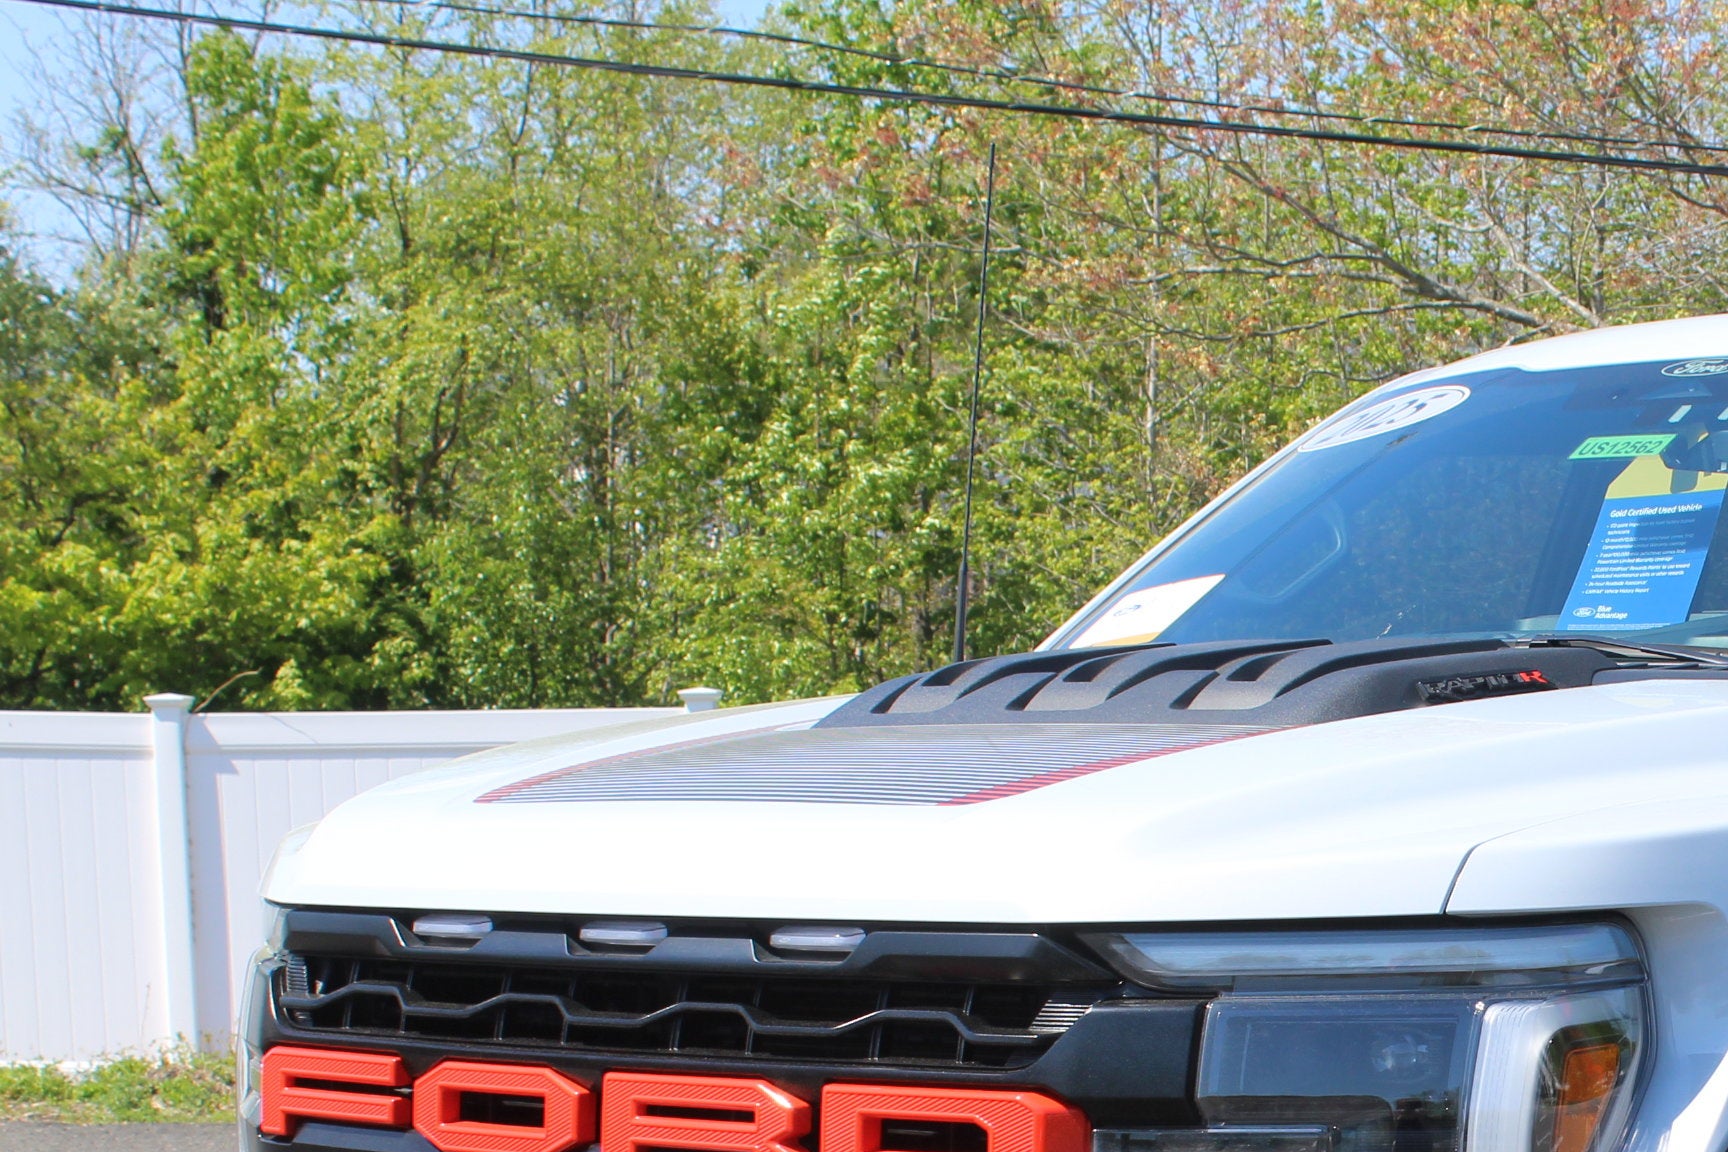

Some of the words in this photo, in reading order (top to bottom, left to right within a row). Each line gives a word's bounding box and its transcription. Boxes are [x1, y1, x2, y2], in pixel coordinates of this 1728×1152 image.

[1578, 440, 1664, 456] US12562
[1610, 509, 1626, 518] Gold
[1628, 507, 1657, 517] Certified
[1658, 505, 1676, 515] Used
[1677, 503, 1703, 513] Vehicle
[1597, 605, 1612, 613] Blue
[1594, 612, 1628, 620] Advantage
